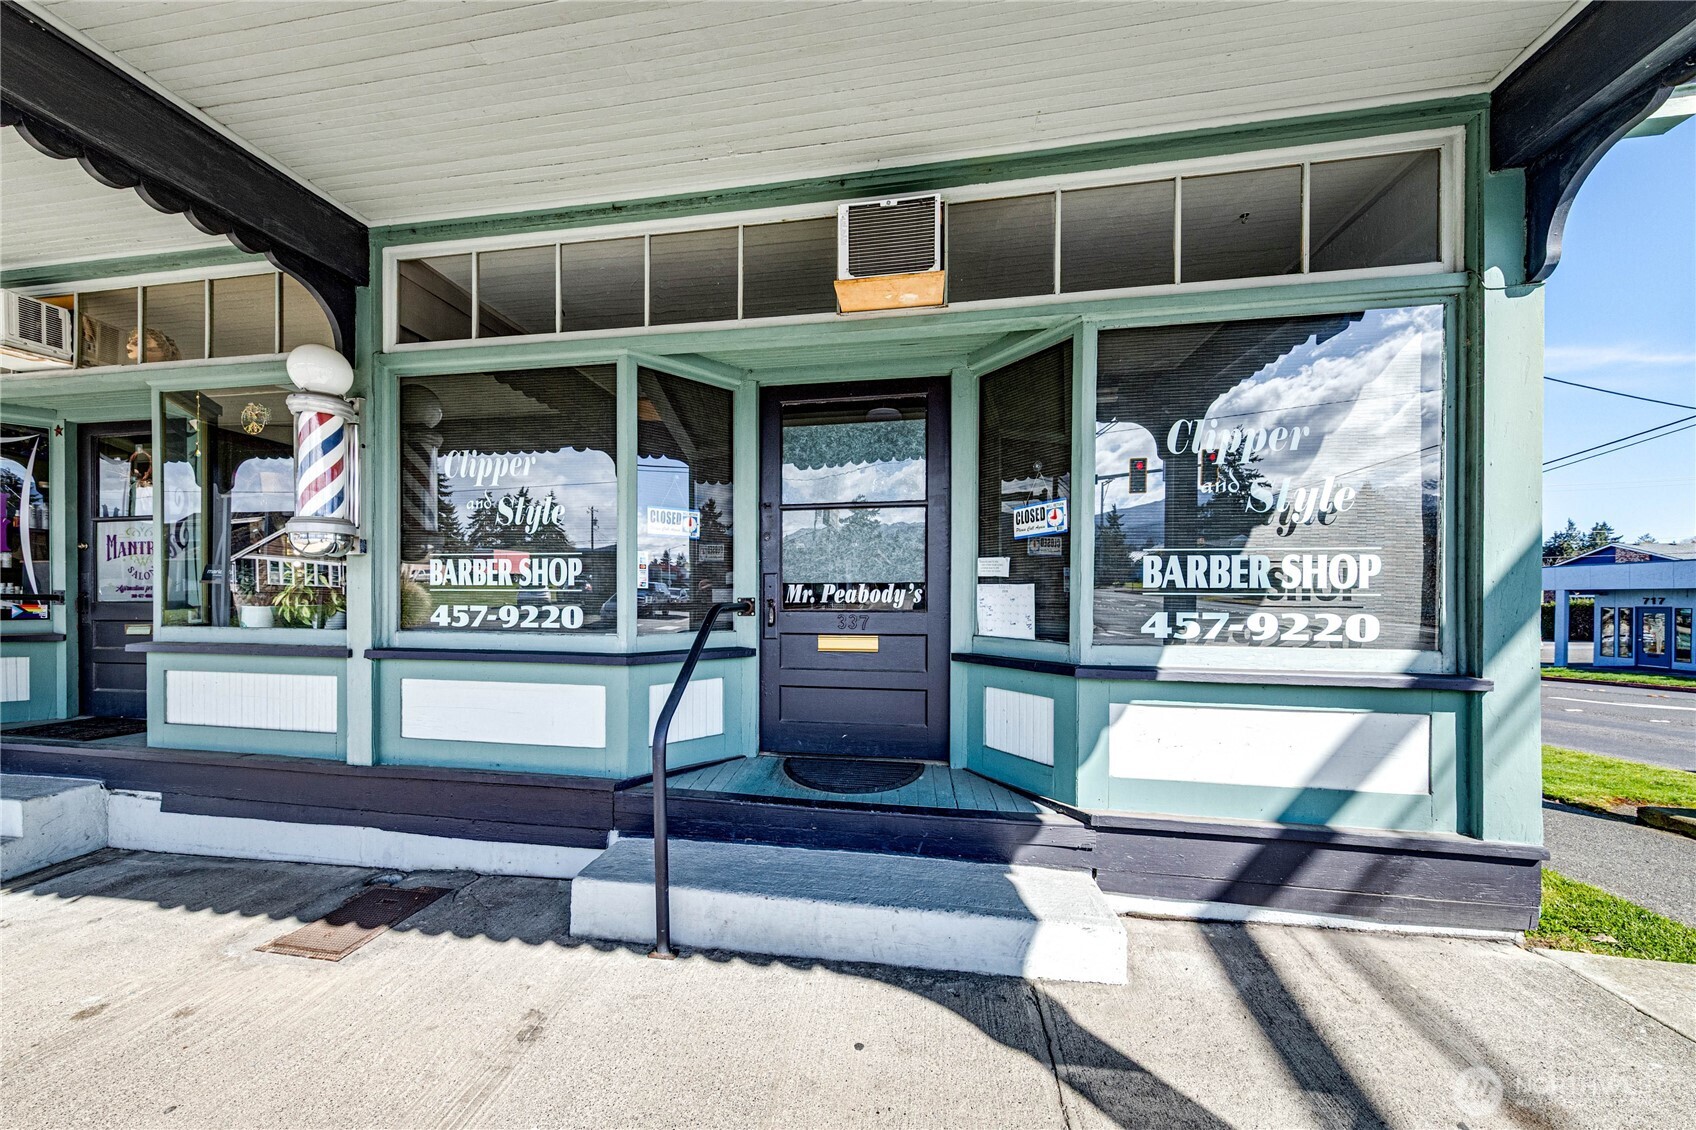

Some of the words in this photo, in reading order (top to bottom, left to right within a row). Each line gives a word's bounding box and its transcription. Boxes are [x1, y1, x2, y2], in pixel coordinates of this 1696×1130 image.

[1166, 418, 1310, 465] Clipper
[444, 449, 536, 487] Clipper
[1200, 468, 1240, 494] and
[1244, 475, 1357, 524] Style
[466, 490, 493, 510] and
[495, 496, 566, 534] Style
[650, 509, 682, 525] CLOSED
[1015, 507, 1046, 525] CLOSED
[429, 558, 513, 586] BARBER
[519, 557, 583, 587] SHOP
[1142, 554, 1273, 589] BARBER
[1281, 553, 1382, 589] SHOP
[784, 583, 815, 604] Mr.
[820, 583, 923, 608] Peabody's
[1642, 597, 1665, 605] 717
[429, 604, 584, 629] 457-9220
[837, 614, 870, 630] 337
[1140, 612, 1381, 643] 457-9220
